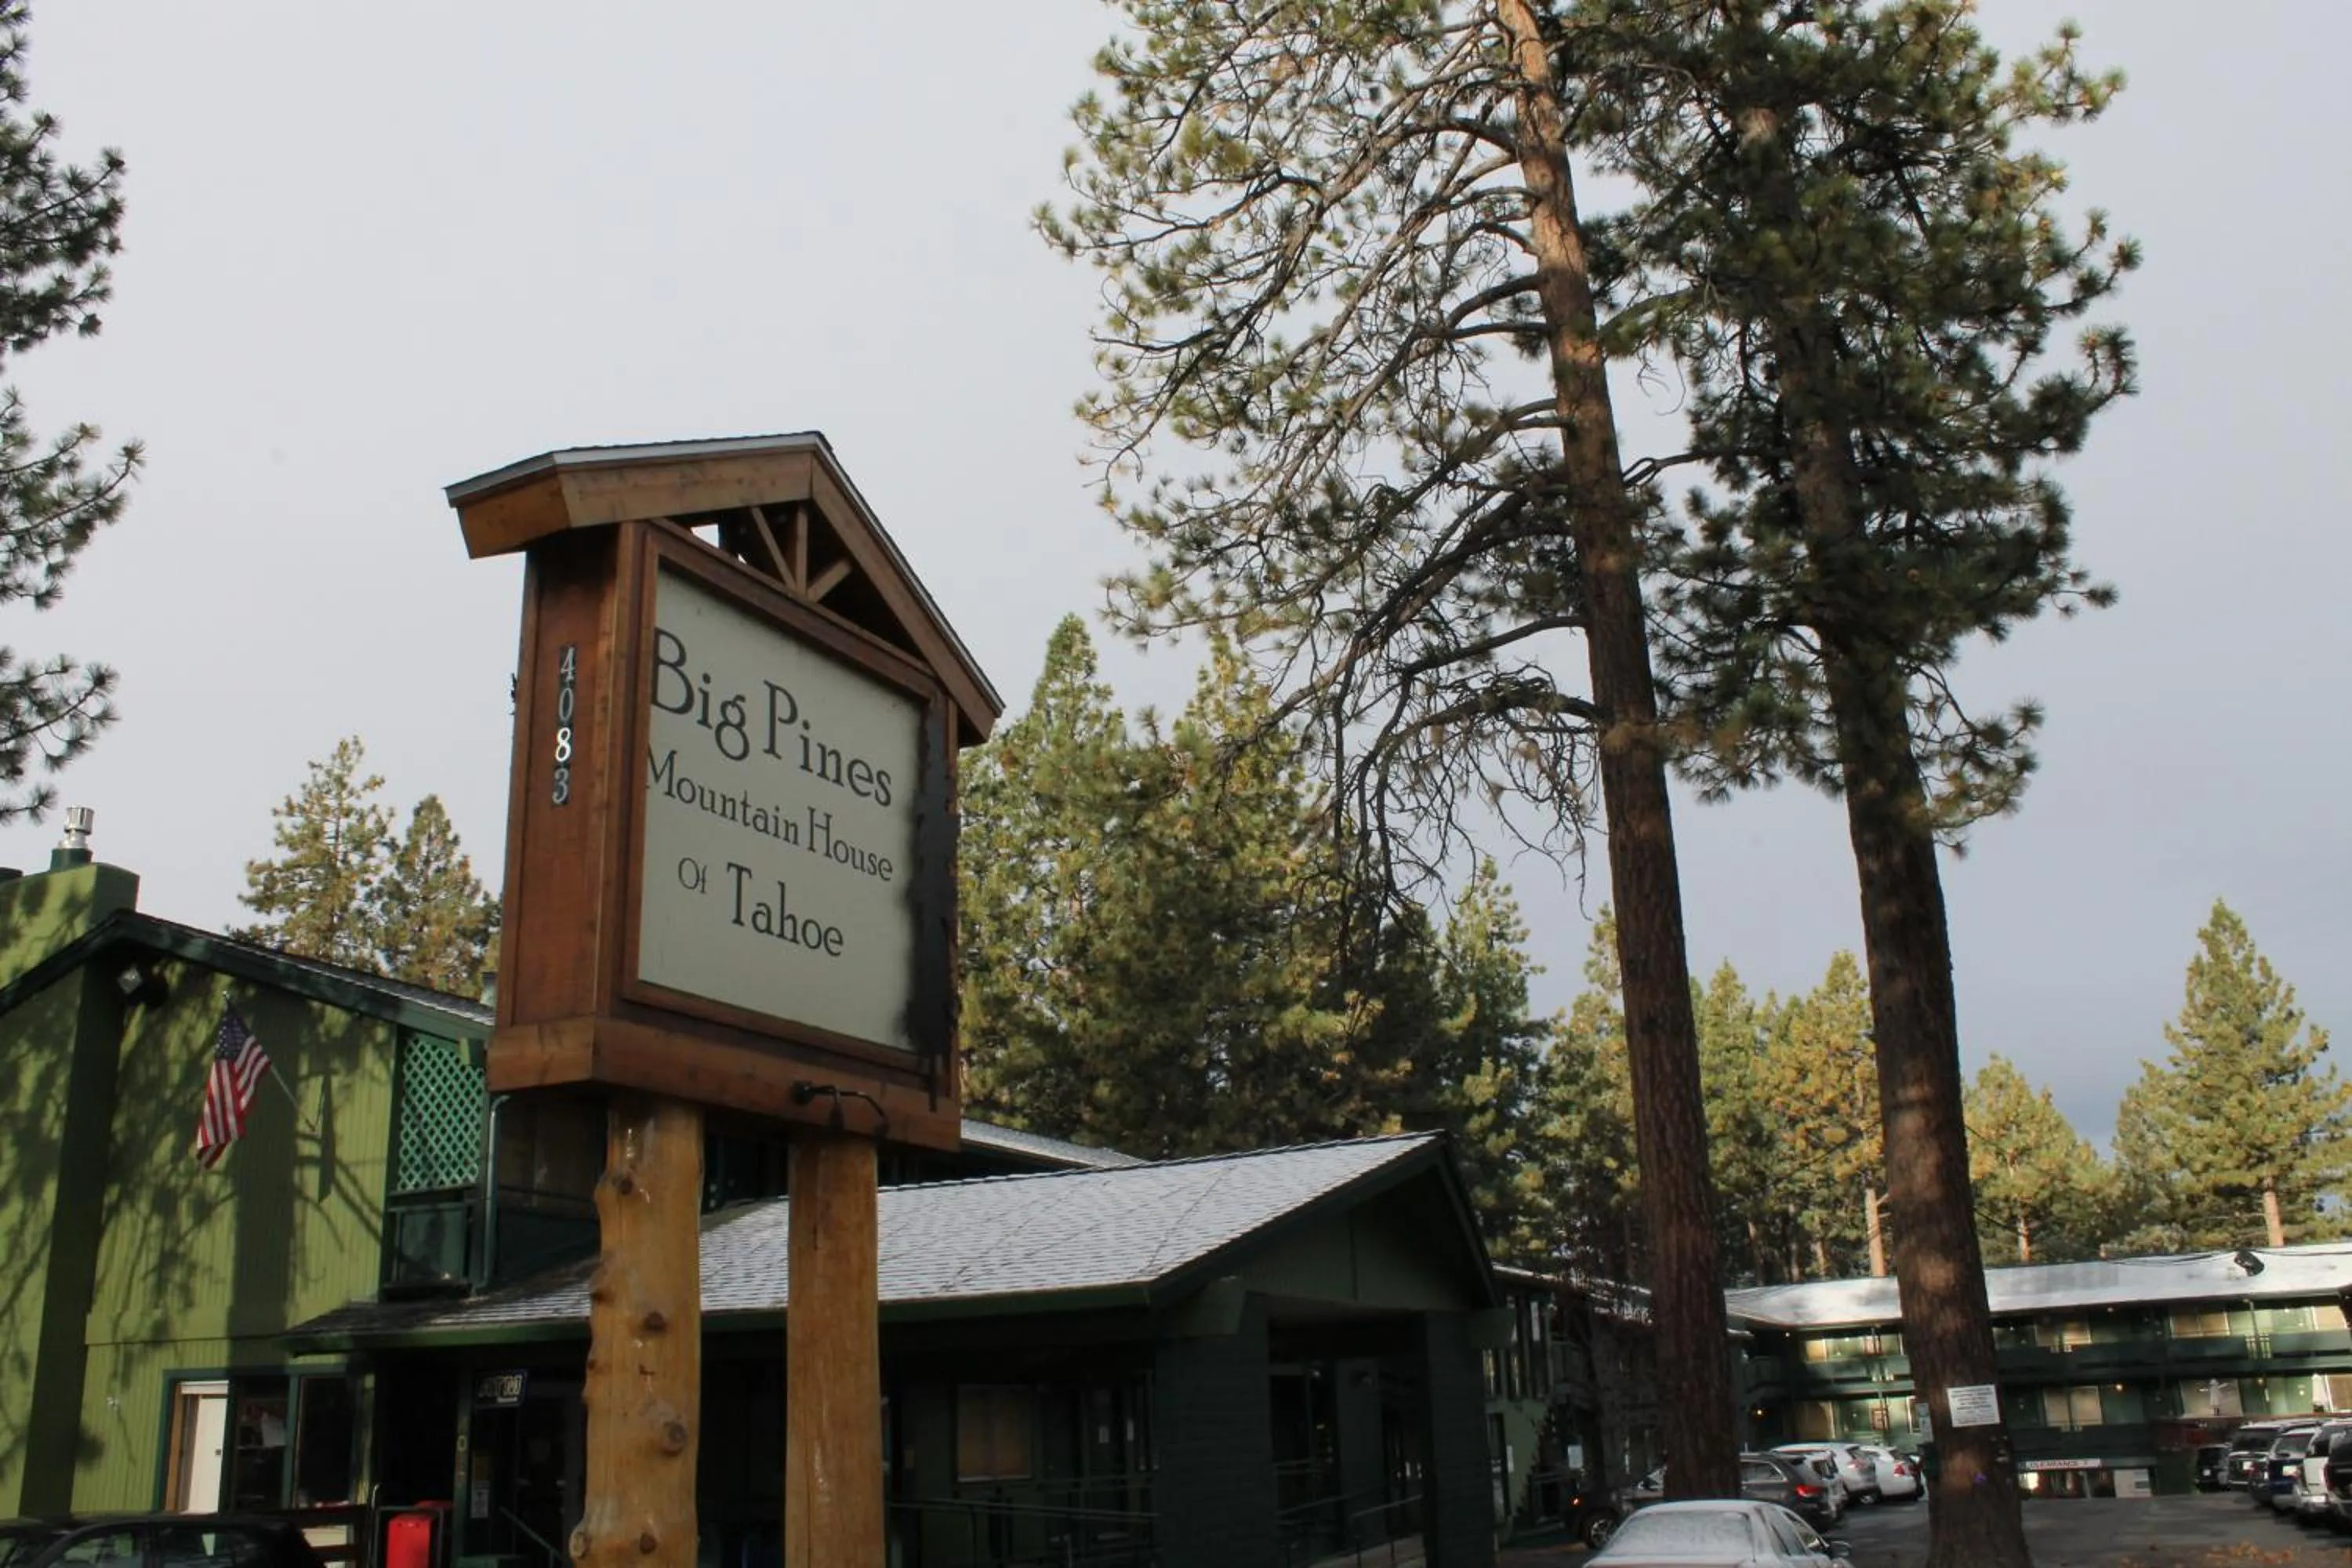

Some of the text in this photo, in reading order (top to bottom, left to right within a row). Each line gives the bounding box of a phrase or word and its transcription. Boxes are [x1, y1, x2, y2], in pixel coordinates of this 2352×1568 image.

[552, 646, 575, 804] 4083
[651, 627, 892, 808] Big Pines
[645, 743, 893, 882] Mountain House
[678, 857, 844, 957] Of Tahoe
